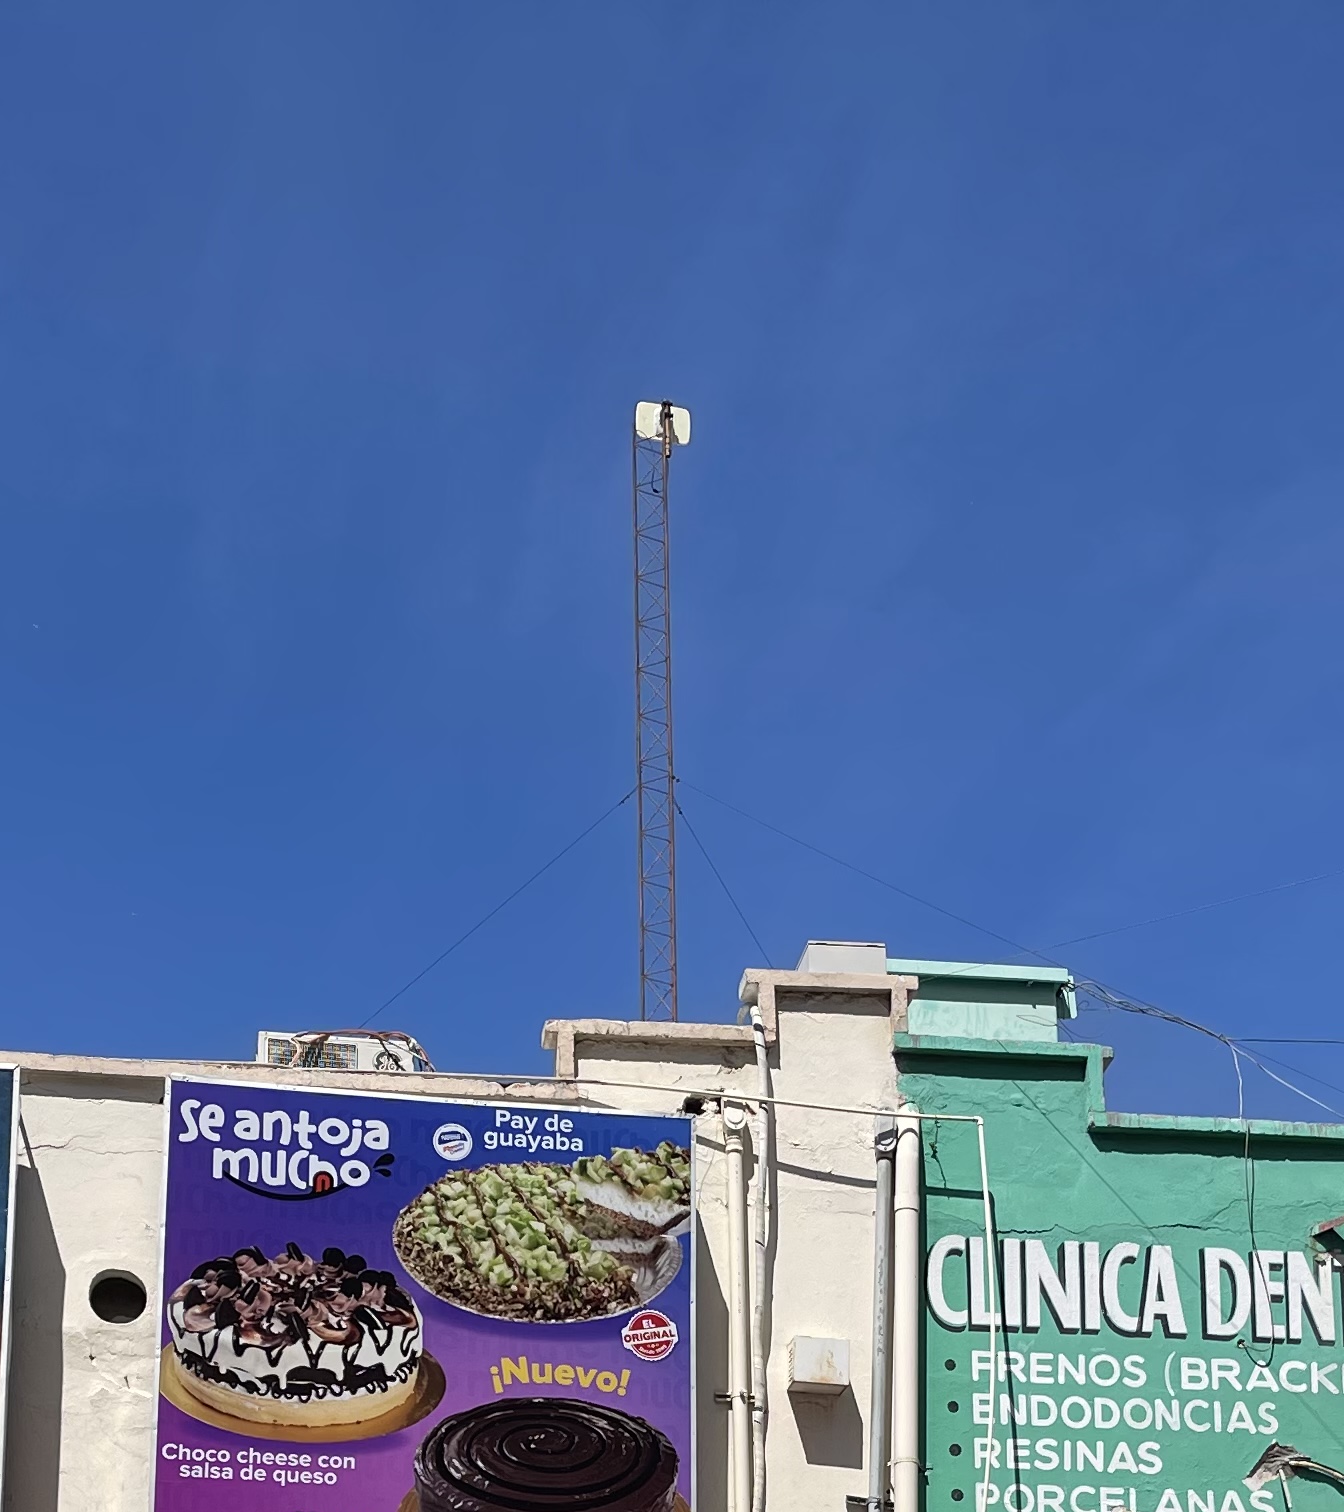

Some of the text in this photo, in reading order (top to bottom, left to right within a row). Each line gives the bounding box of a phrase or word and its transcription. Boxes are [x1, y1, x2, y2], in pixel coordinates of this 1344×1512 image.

[179, 1099, 389, 1151] Se antoja
[495, 1109, 574, 1134] Pay de
[484, 1131, 583, 1154] guayaba
[927, 1235, 1188, 1334] CLINICA
[624, 1329, 676, 1343] ORIGINAL
[642, 1319, 656, 1328] EL
[489, 1356, 631, 1396] ¡Nuevo!
[971, 1350, 1146, 1387] FRENOS
[972, 1394, 1279, 1434] ENDODONCIAS
[161, 1444, 356, 1470] Choco cheese con
[974, 1438, 1163, 1474] RESINAS
[179, 1461, 337, 1487] salsa de queso
